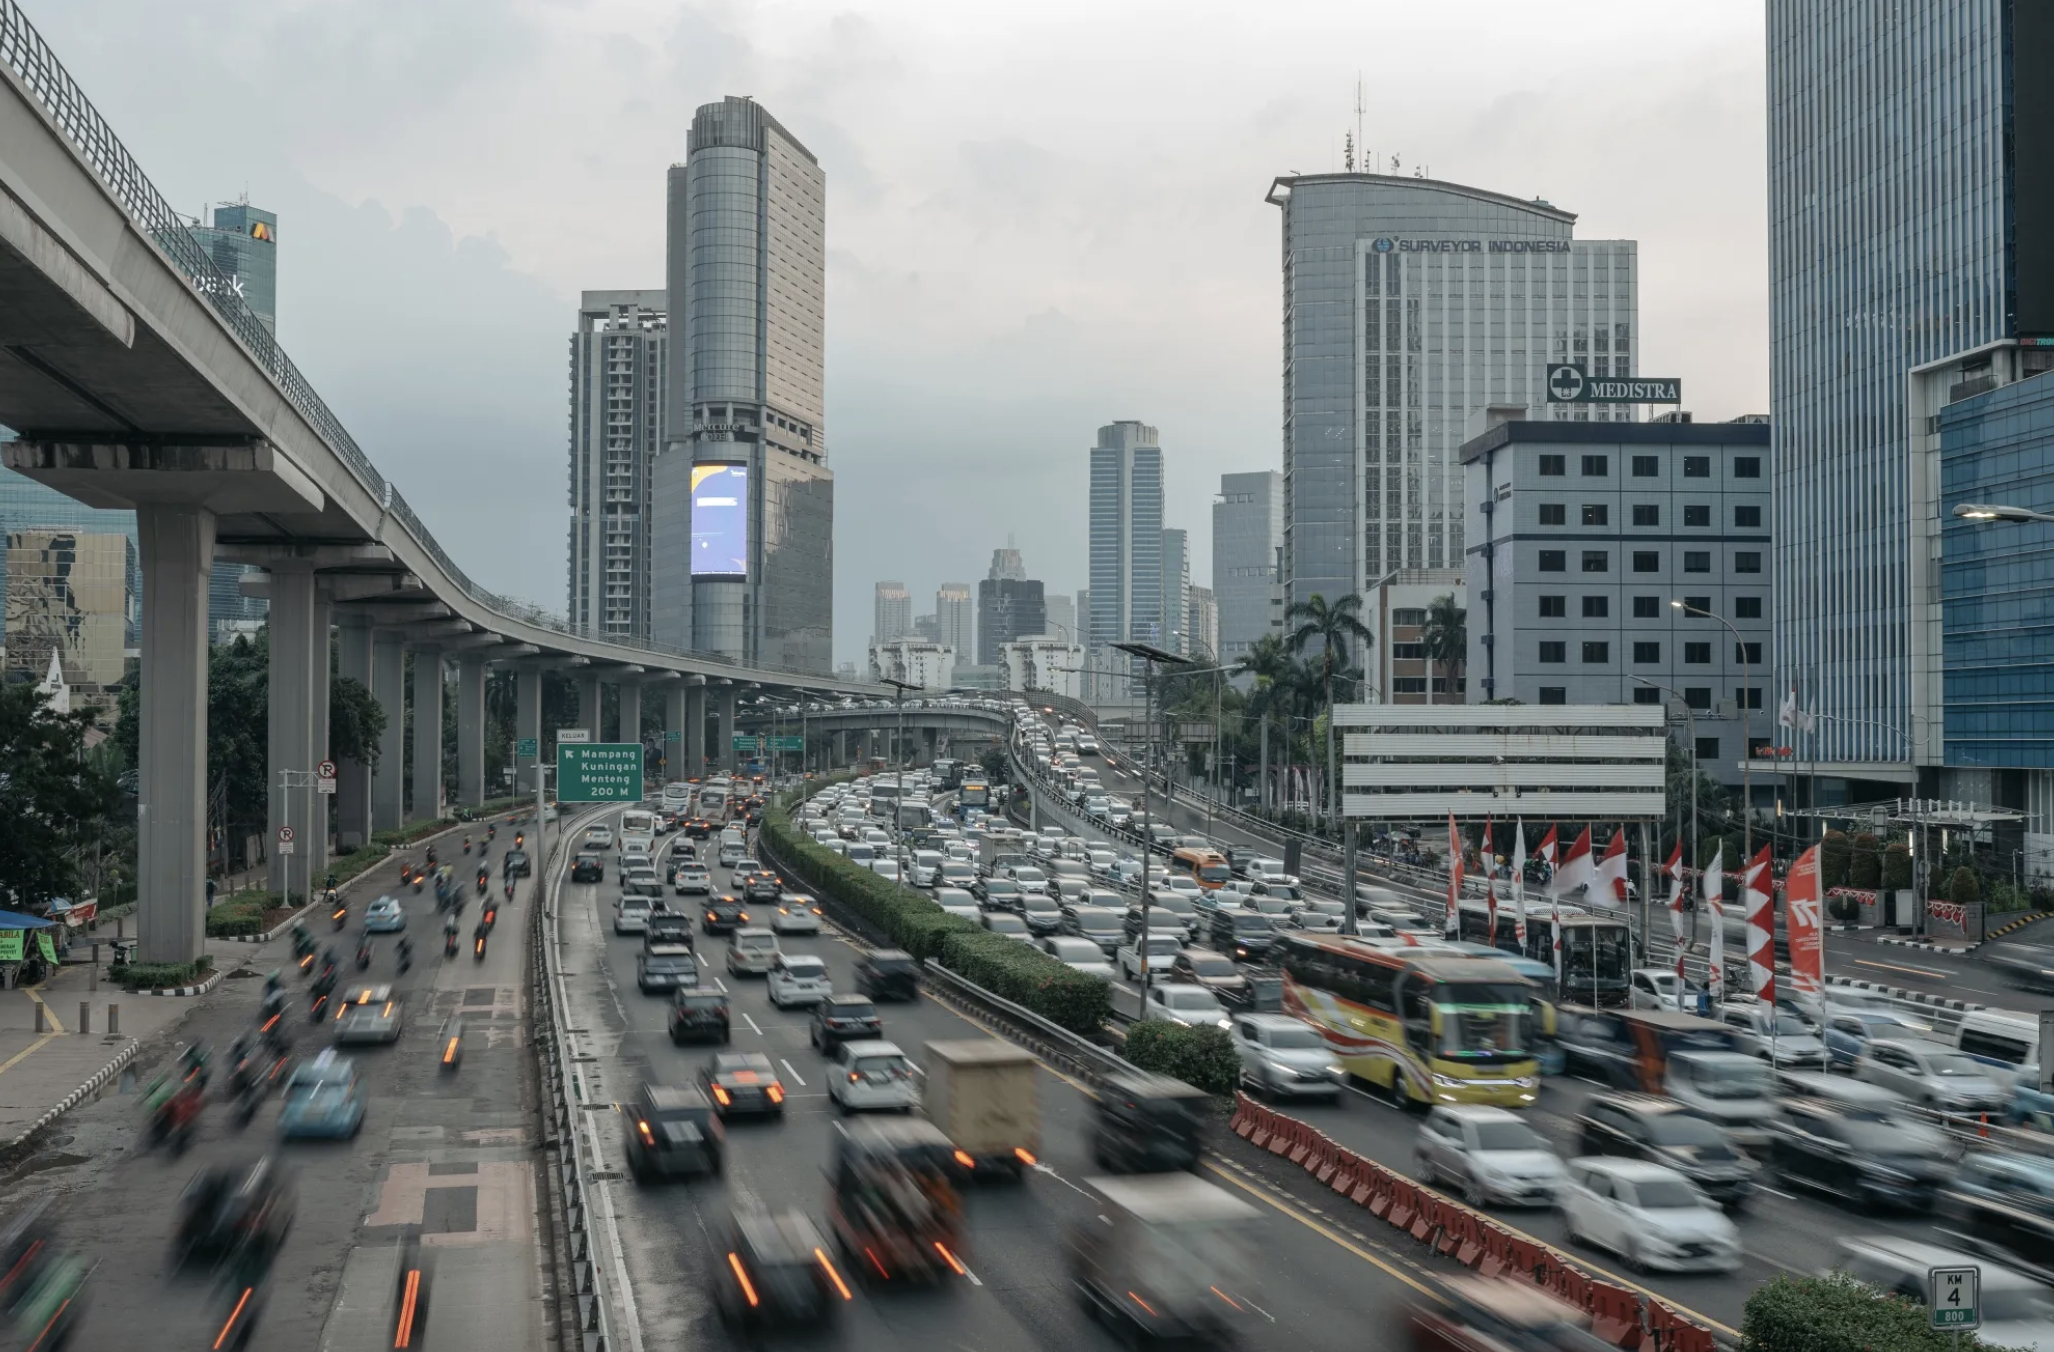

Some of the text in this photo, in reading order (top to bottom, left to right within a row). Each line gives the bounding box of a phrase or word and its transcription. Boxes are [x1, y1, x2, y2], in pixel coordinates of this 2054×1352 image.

[1399, 240, 1571, 253] SURVEYOR INDONESIA
[1590, 382, 1678, 399] MEDISTRA
[582, 750, 635, 760] Mampang
[581, 762, 637, 773] Kuningan
[581, 774, 630, 785] Menteng
[591, 787, 613, 795] 200
[1947, 1275, 1962, 1284] KM
[1947, 1288, 1960, 1306] 4
[1945, 1311, 1964, 1321] 800
